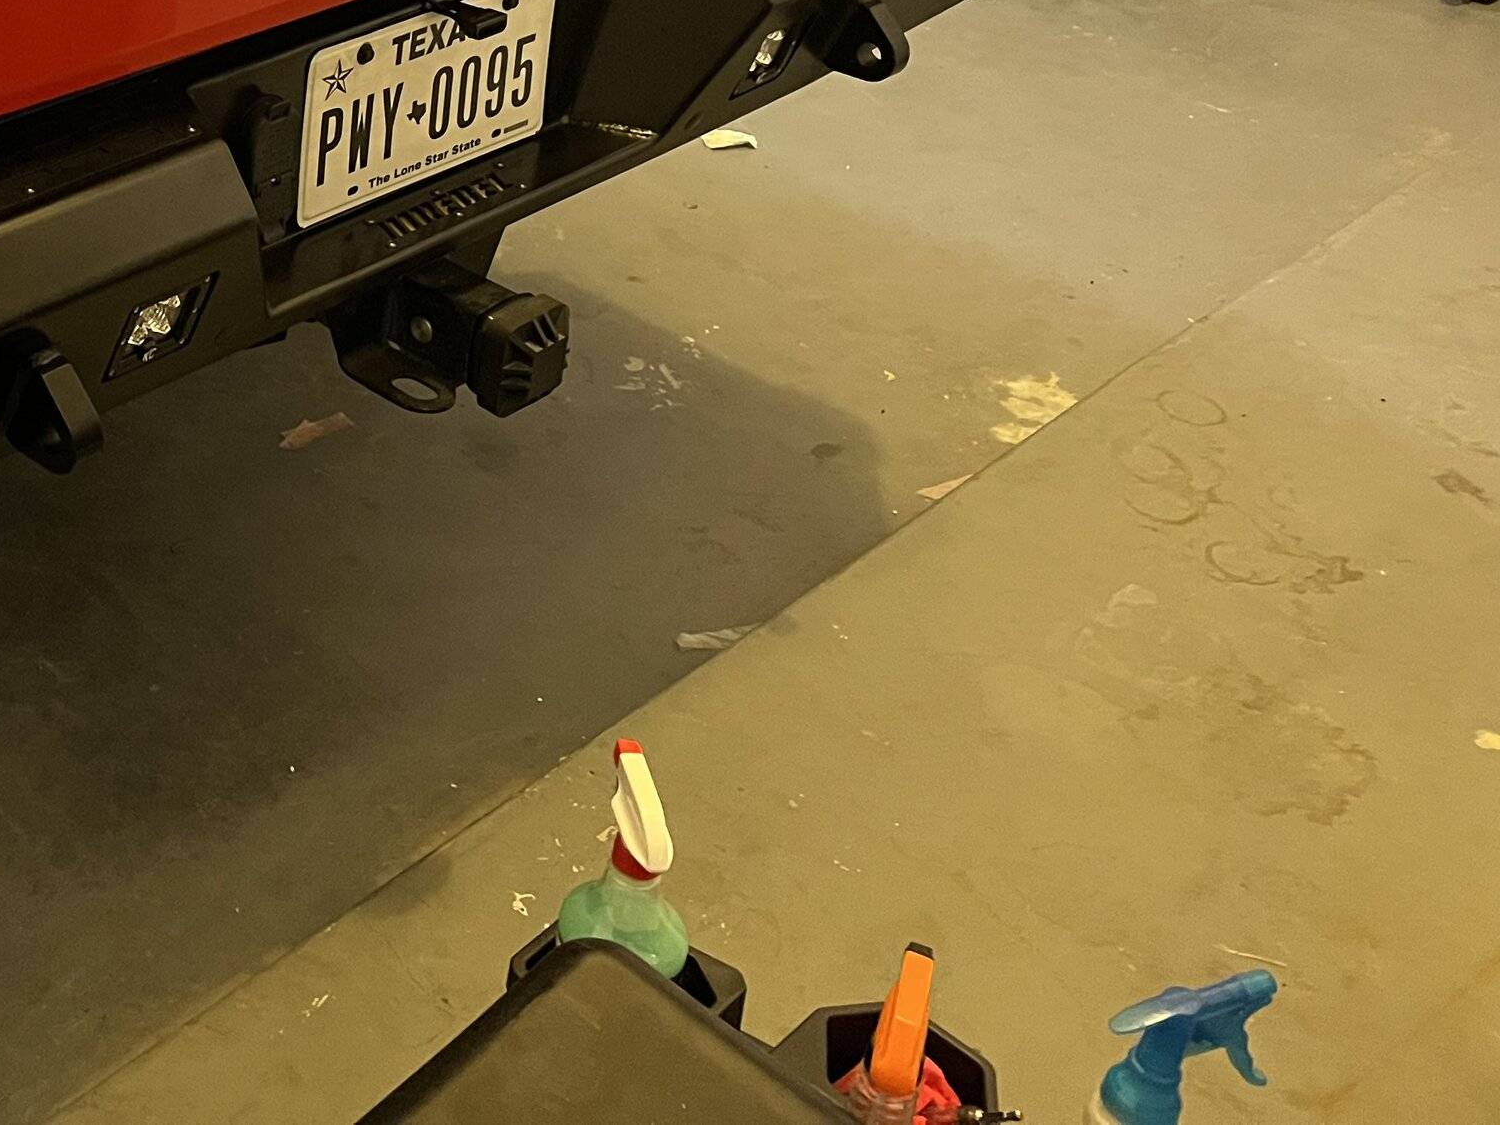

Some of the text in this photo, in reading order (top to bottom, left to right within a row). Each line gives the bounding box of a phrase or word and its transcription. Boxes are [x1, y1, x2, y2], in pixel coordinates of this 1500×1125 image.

[392, 18, 468, 65] TEXA
[316, 33, 537, 187] PWY 0095
[368, 137, 482, 188] The Lone Star State
